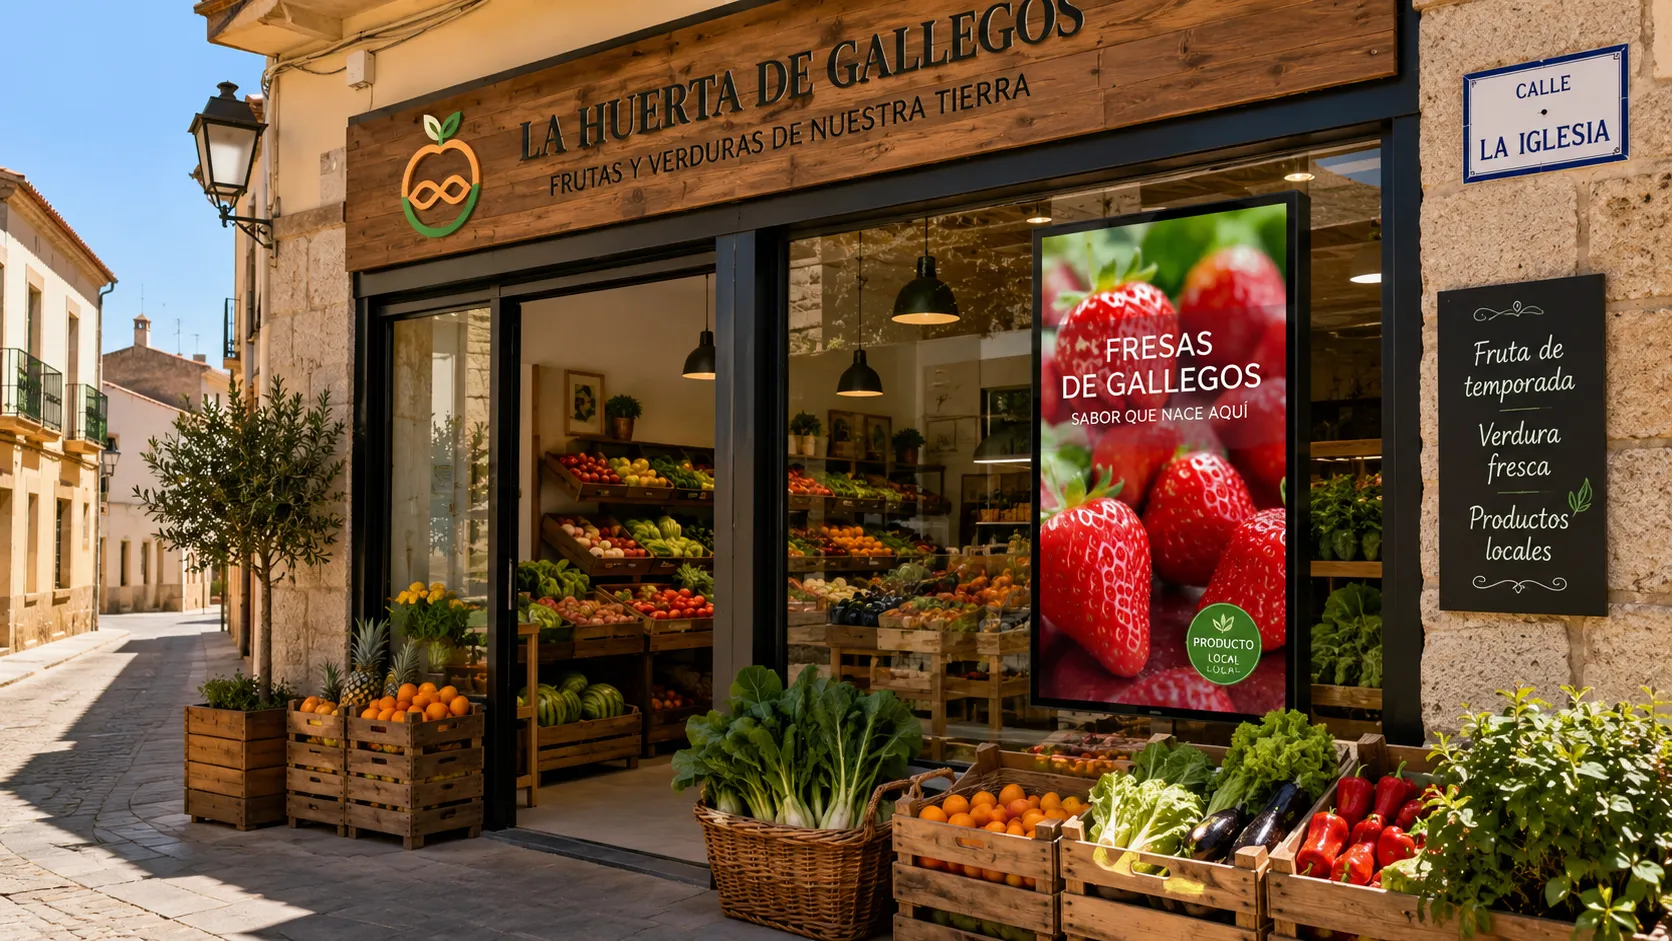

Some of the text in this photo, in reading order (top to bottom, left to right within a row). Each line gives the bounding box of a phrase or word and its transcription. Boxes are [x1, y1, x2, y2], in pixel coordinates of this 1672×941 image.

[519, 0, 1086, 162] LA HUERTA DE GALLEGOS
[1516, 75, 1571, 99] CALLE
[550, 73, 1031, 197] FRUTAS Y VERDURAS DE NUESTRA TIERRA
[1480, 119, 1611, 161] LA IGLESIA
[1106, 331, 1213, 363] FRESAS
[1474, 334, 1564, 366] Fruta de
[1062, 362, 1262, 399] DE GALLEGOS
[1464, 366, 1576, 403] temporada
[1071, 400, 1248, 426] SABOR QUE NACE AQUÍ
[1479, 420, 1561, 446] Verdura
[1487, 452, 1551, 485] fresca
[1469, 504, 1569, 530] Productos
[1486, 536, 1552, 561] locales
[1193, 637, 1255, 651] PRODUCTO
[1208, 653, 1240, 666] LOCAL
